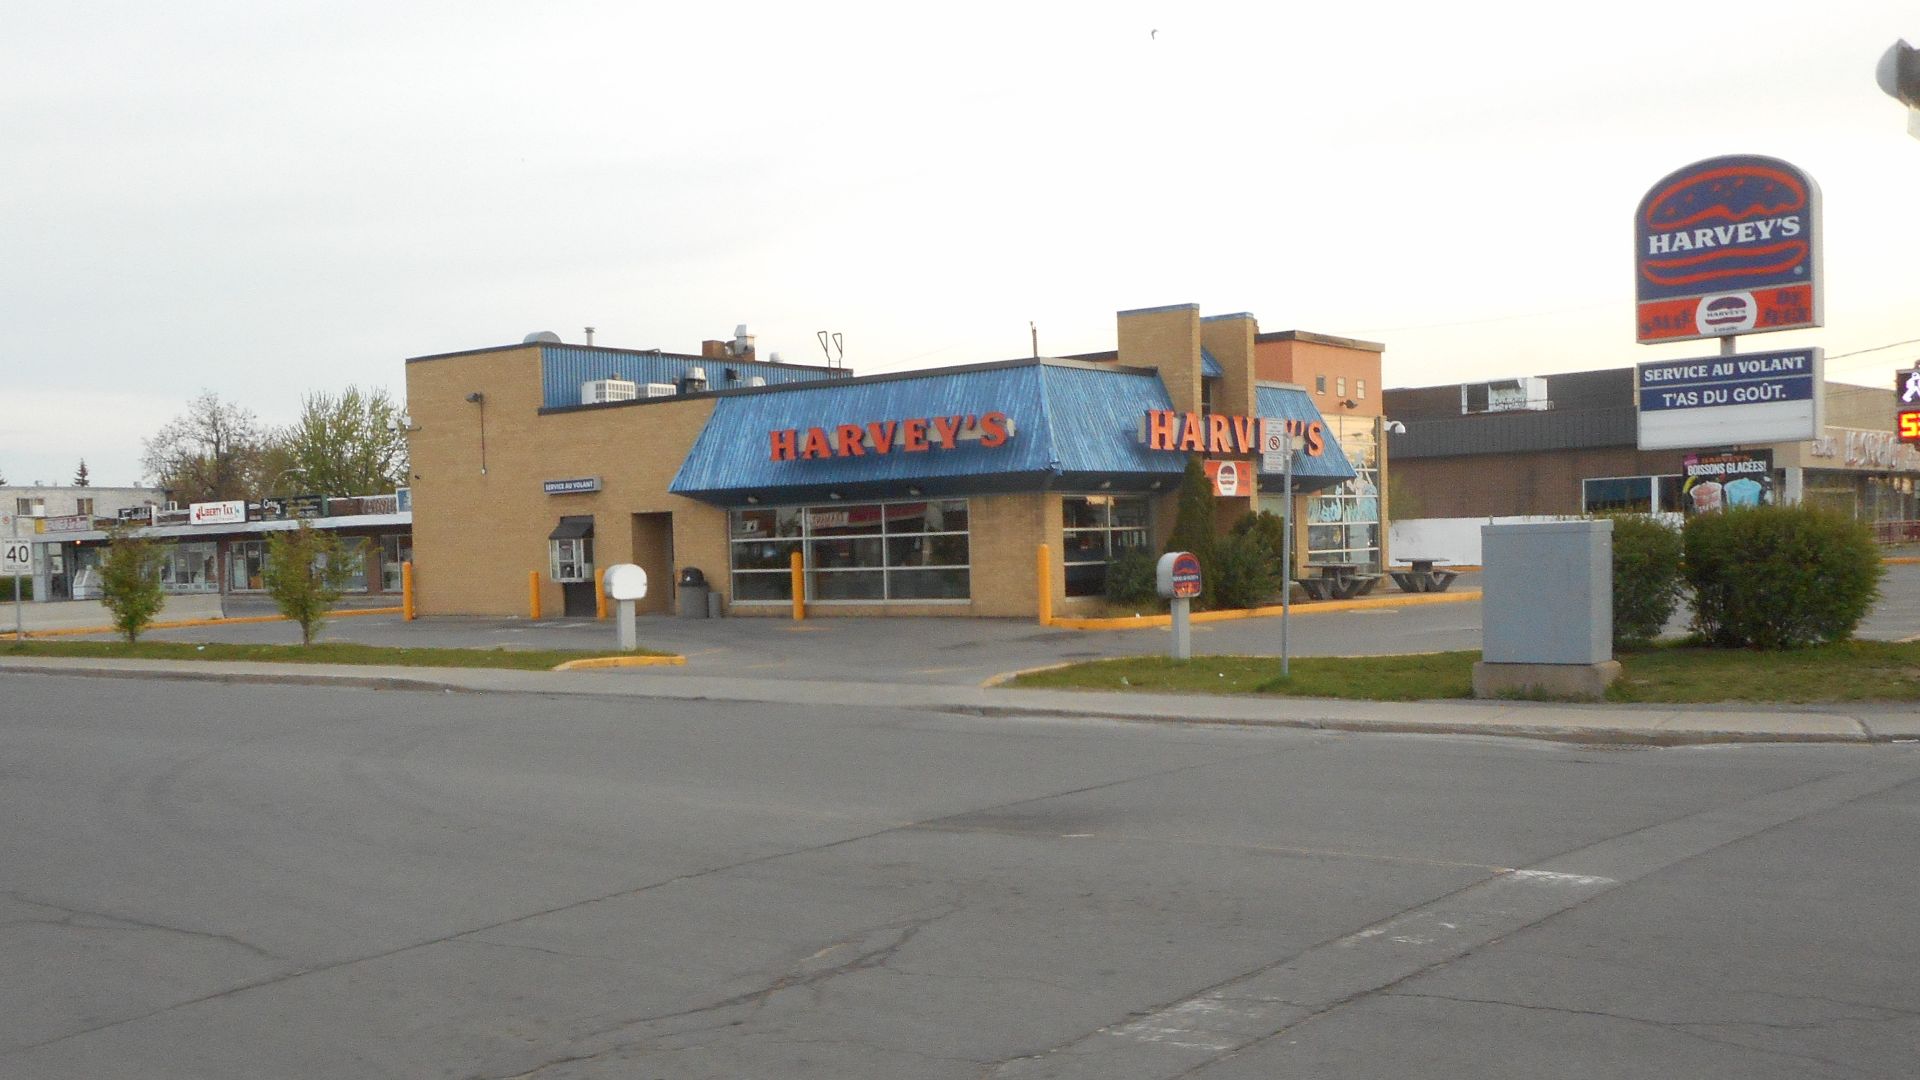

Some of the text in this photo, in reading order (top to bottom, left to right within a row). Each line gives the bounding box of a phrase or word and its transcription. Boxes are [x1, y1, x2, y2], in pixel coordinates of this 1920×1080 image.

[1648, 215, 1801, 255] HARVEY'S
[1644, 356, 1806, 382] SERVICE AU VOLANT
[1662, 383, 1787, 407] T'AS DU GOÛT.
[768, 411, 1008, 462] HARVEY'S
[1687, 463, 1726, 476] BOISSONS
[6, 545, 29, 563] 40
